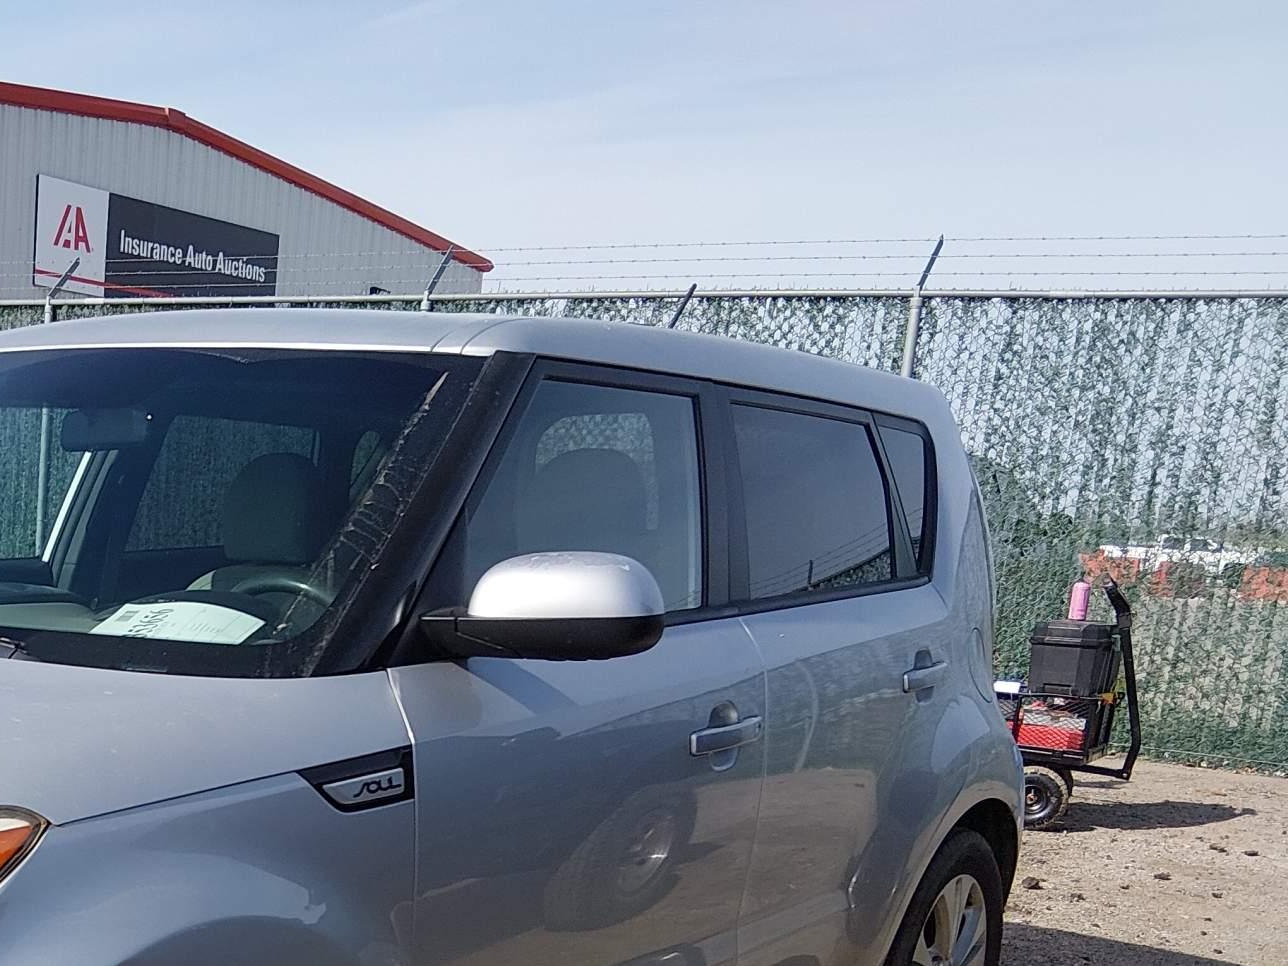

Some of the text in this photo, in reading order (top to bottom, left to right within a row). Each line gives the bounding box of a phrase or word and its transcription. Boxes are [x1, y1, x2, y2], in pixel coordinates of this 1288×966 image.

[120, 229, 266, 282] Insurance Auto Auctions
